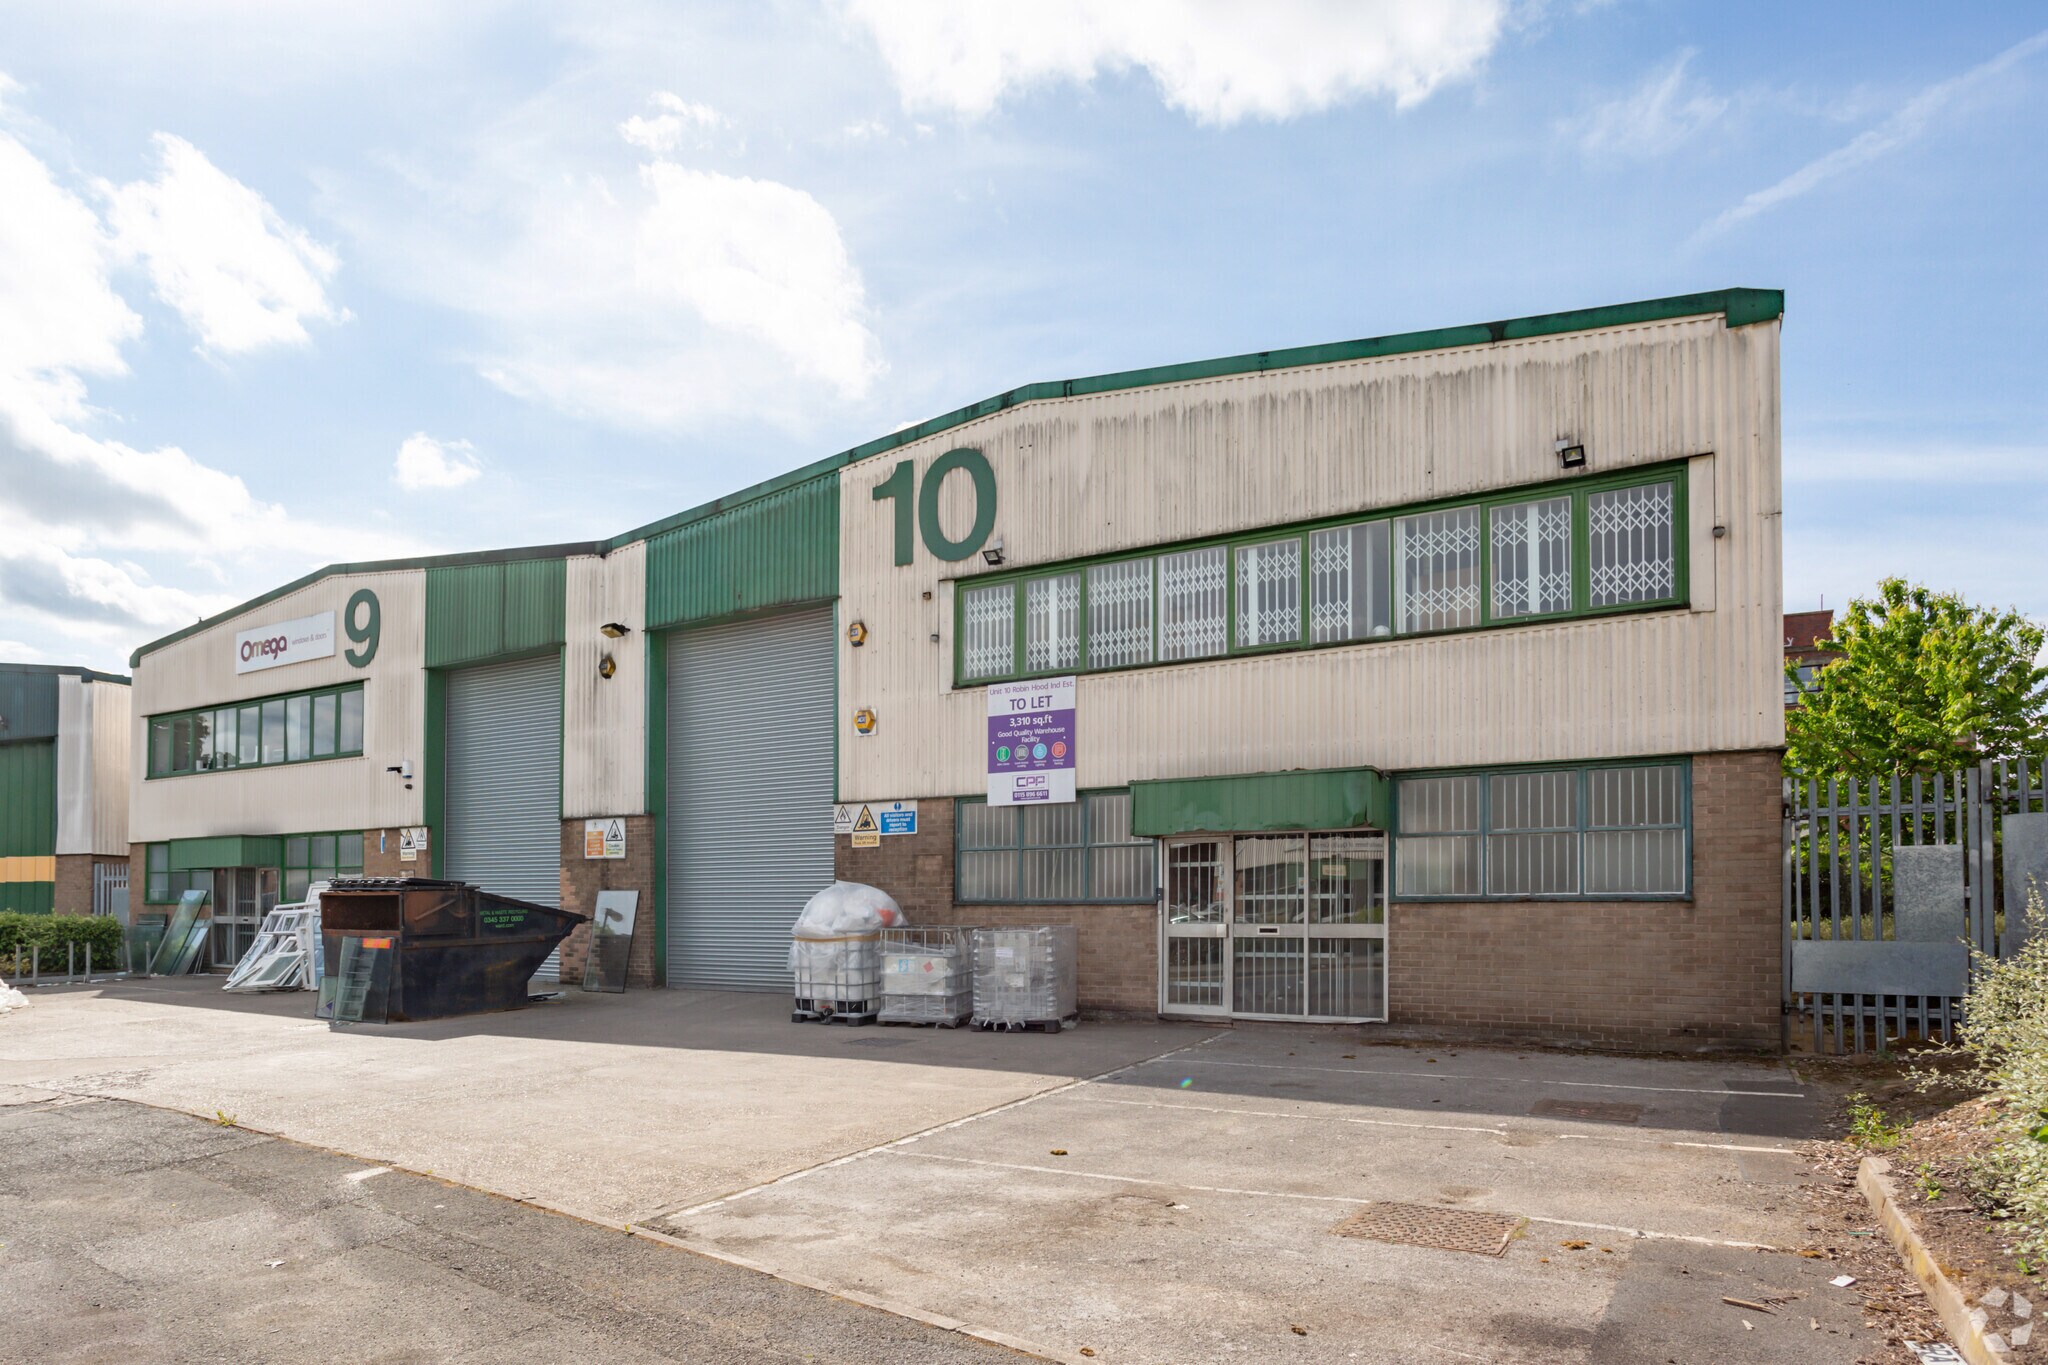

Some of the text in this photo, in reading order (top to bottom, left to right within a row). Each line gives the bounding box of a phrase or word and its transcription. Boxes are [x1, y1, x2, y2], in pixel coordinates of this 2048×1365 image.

[872, 447, 997, 567] 10
[344, 589, 381, 668] 9
[241, 636, 287, 662] Omega
[1032, 682, 1049, 691] Hood
[1051, 681, 1060, 689] Ind
[1010, 695, 1052, 710] TO LET
[1009, 714, 1052, 727] 3,310 sq.ft
[1014, 729, 1033, 738] Quality
[1034, 726, 1065, 735] Warehouse
[1022, 735, 1040, 743] Facility
